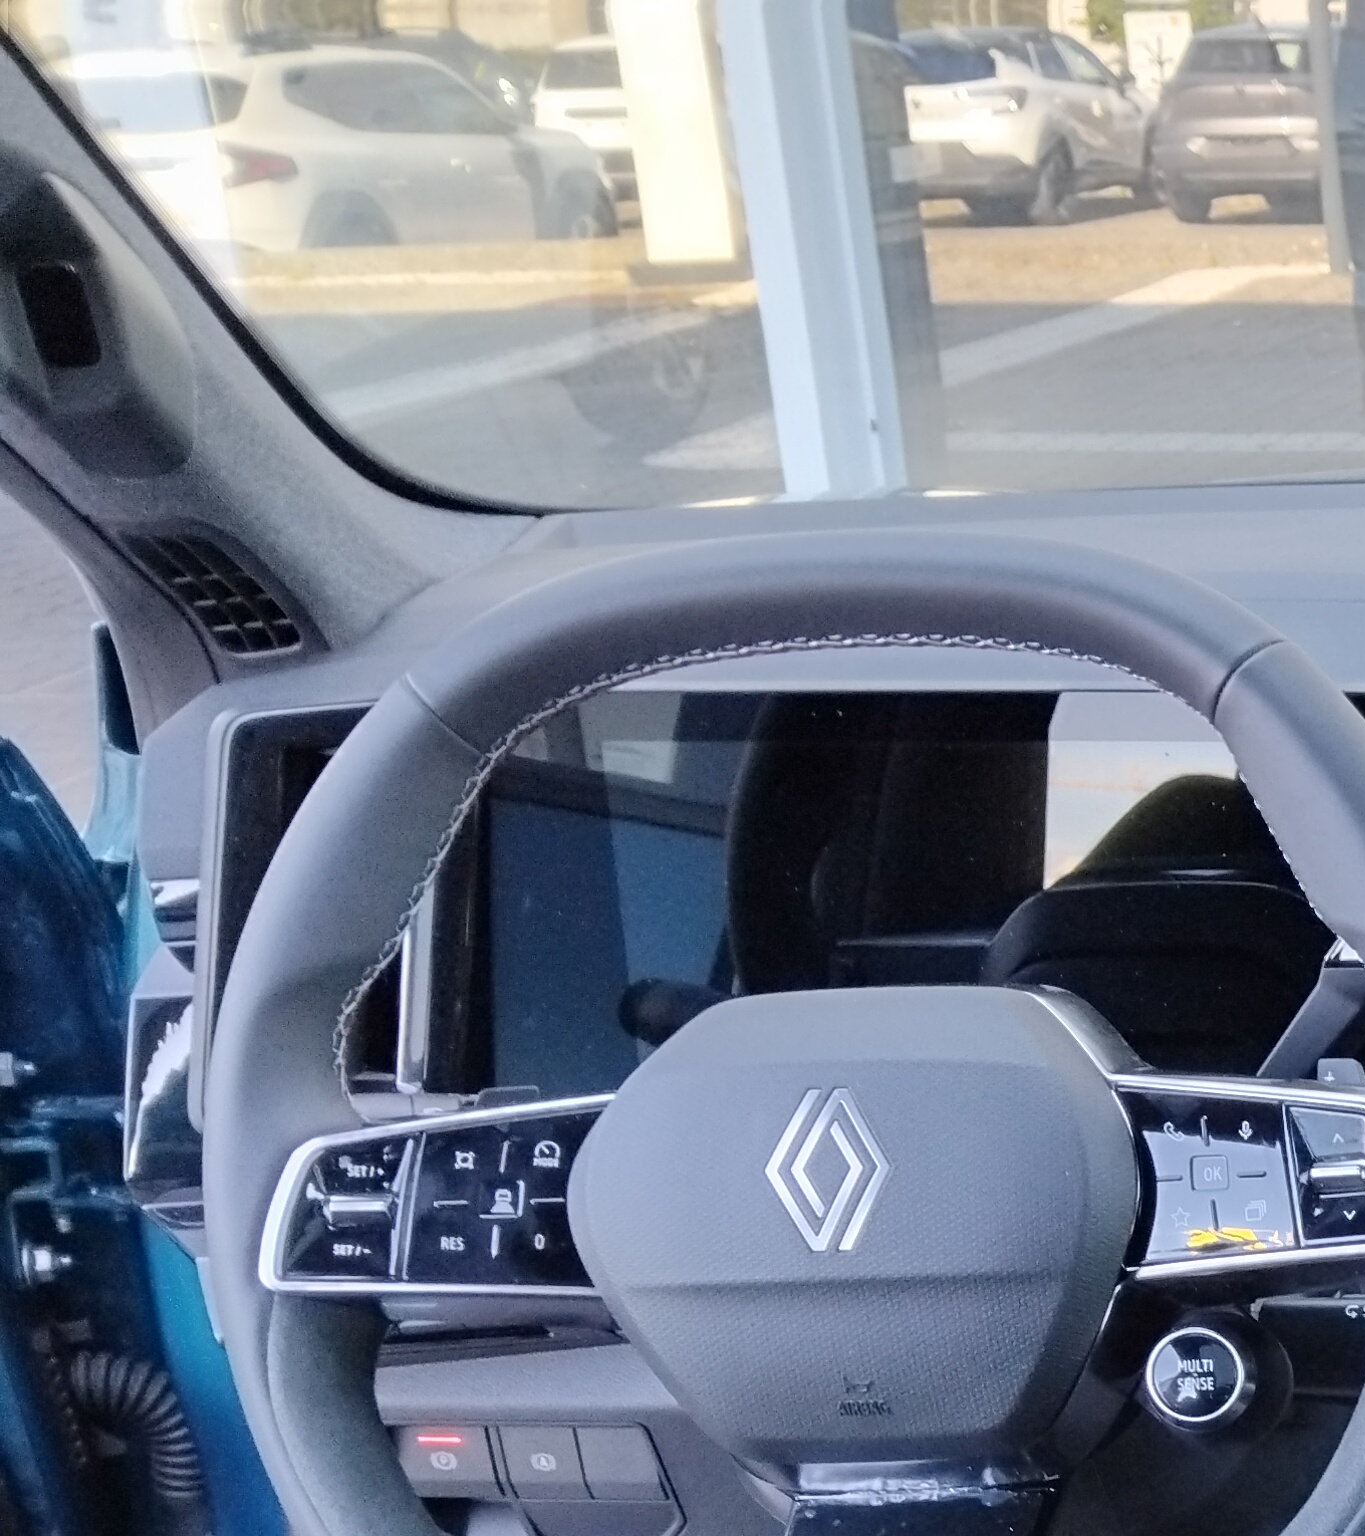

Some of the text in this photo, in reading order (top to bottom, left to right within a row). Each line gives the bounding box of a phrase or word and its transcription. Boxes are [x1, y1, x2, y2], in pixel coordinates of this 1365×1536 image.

[1203, 1166, 1223, 1181] OK
[440, 1236, 465, 1251] RES
[1177, 1358, 1214, 1373] MULTI
[1176, 1376, 1215, 1392] SENSE
[838, 1399, 892, 1417] AIRBAG
